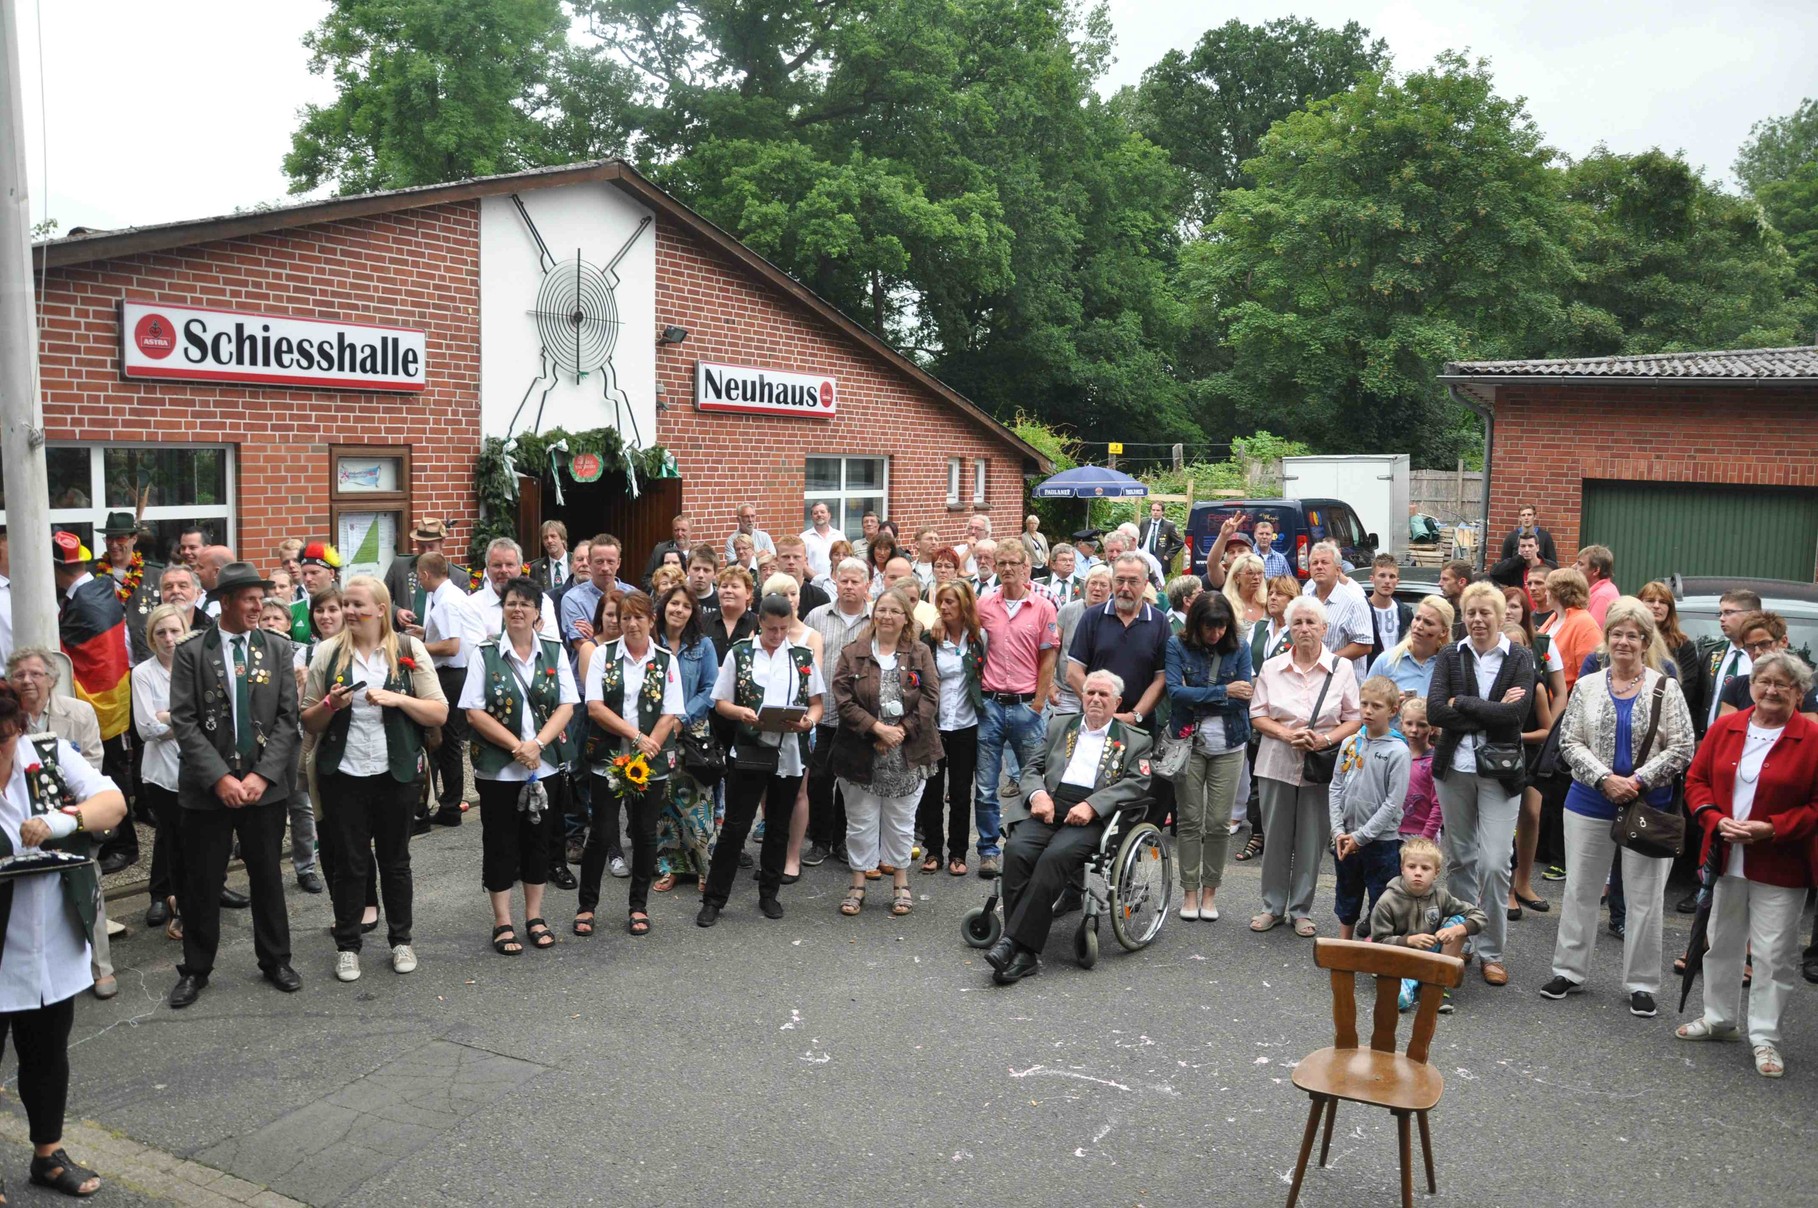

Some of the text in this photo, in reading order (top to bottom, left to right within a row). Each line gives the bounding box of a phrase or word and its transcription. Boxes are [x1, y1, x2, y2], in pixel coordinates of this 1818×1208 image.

[143, 338, 169, 347] ASTRA
[183, 318, 419, 378] Schiesshalle
[705, 366, 818, 407] Neuhaus
